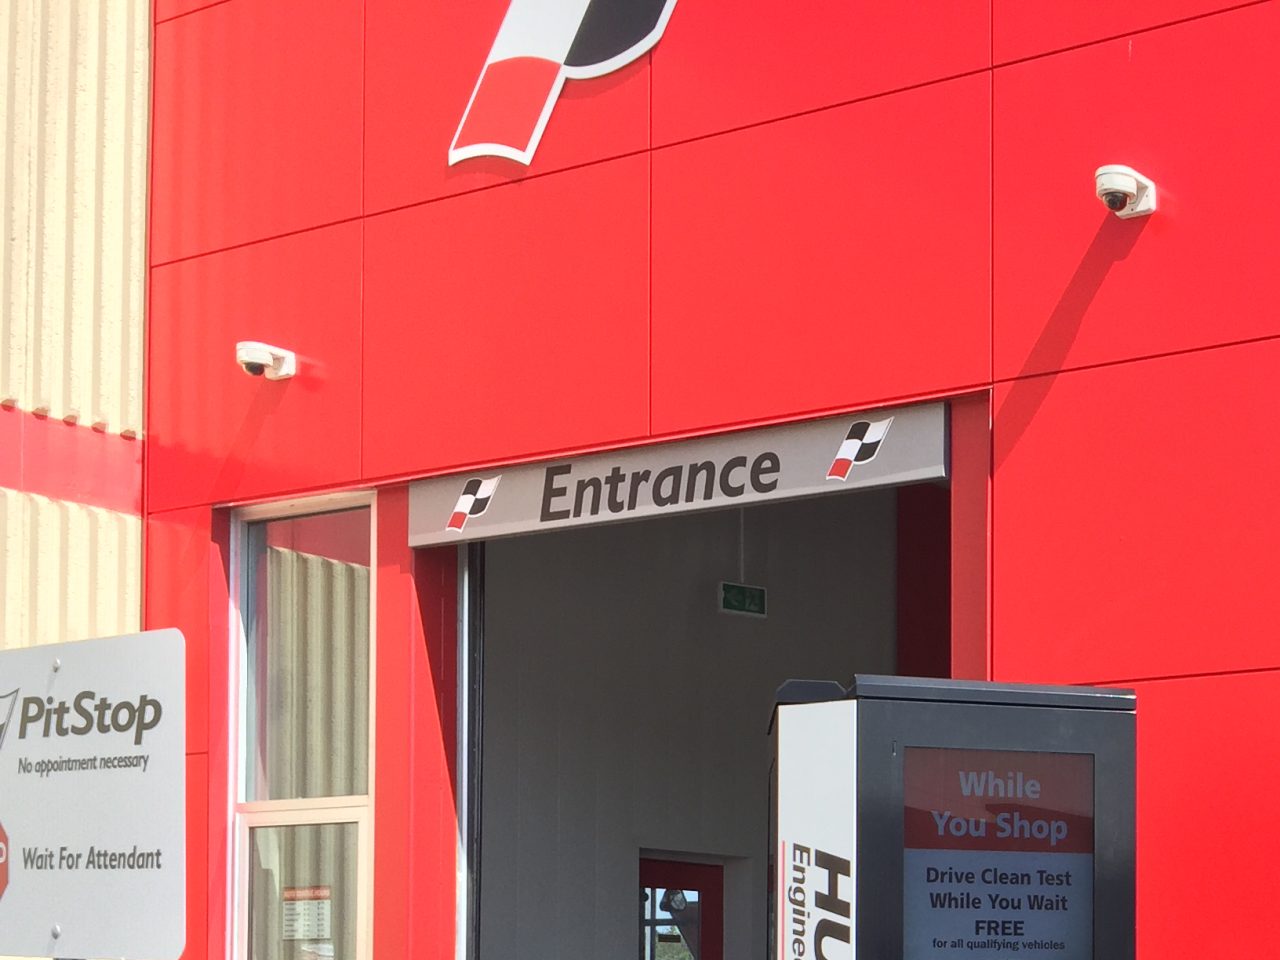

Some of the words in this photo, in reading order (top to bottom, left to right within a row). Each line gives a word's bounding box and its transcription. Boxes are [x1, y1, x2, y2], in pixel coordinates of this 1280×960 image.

[539, 451, 781, 522] Entrance
[18, 691, 162, 745] PitStop
[18, 757, 33, 774] No
[35, 756, 97, 777] appointment
[99, 754, 149, 772] necessary
[959, 771, 1041, 799] While
[931, 810, 986, 838] You
[996, 812, 1068, 846] Shop
[23, 847, 54, 870] Wait
[58, 847, 81, 870] For
[85, 846, 162, 870] Attendant
[926, 867, 975, 884] Drive
[981, 868, 1031, 885] Clean
[1037, 870, 1072, 886] Test
[930, 893, 981, 909] While
[988, 894, 1022, 910] You
[1027, 895, 1068, 911] Wait
[975, 920, 1025, 936] FREE
[933, 938, 947, 948] for
[950, 939, 964, 948] all
[967, 939, 1020, 951] qualifying
[1022, 940, 1065, 950] vehicles
